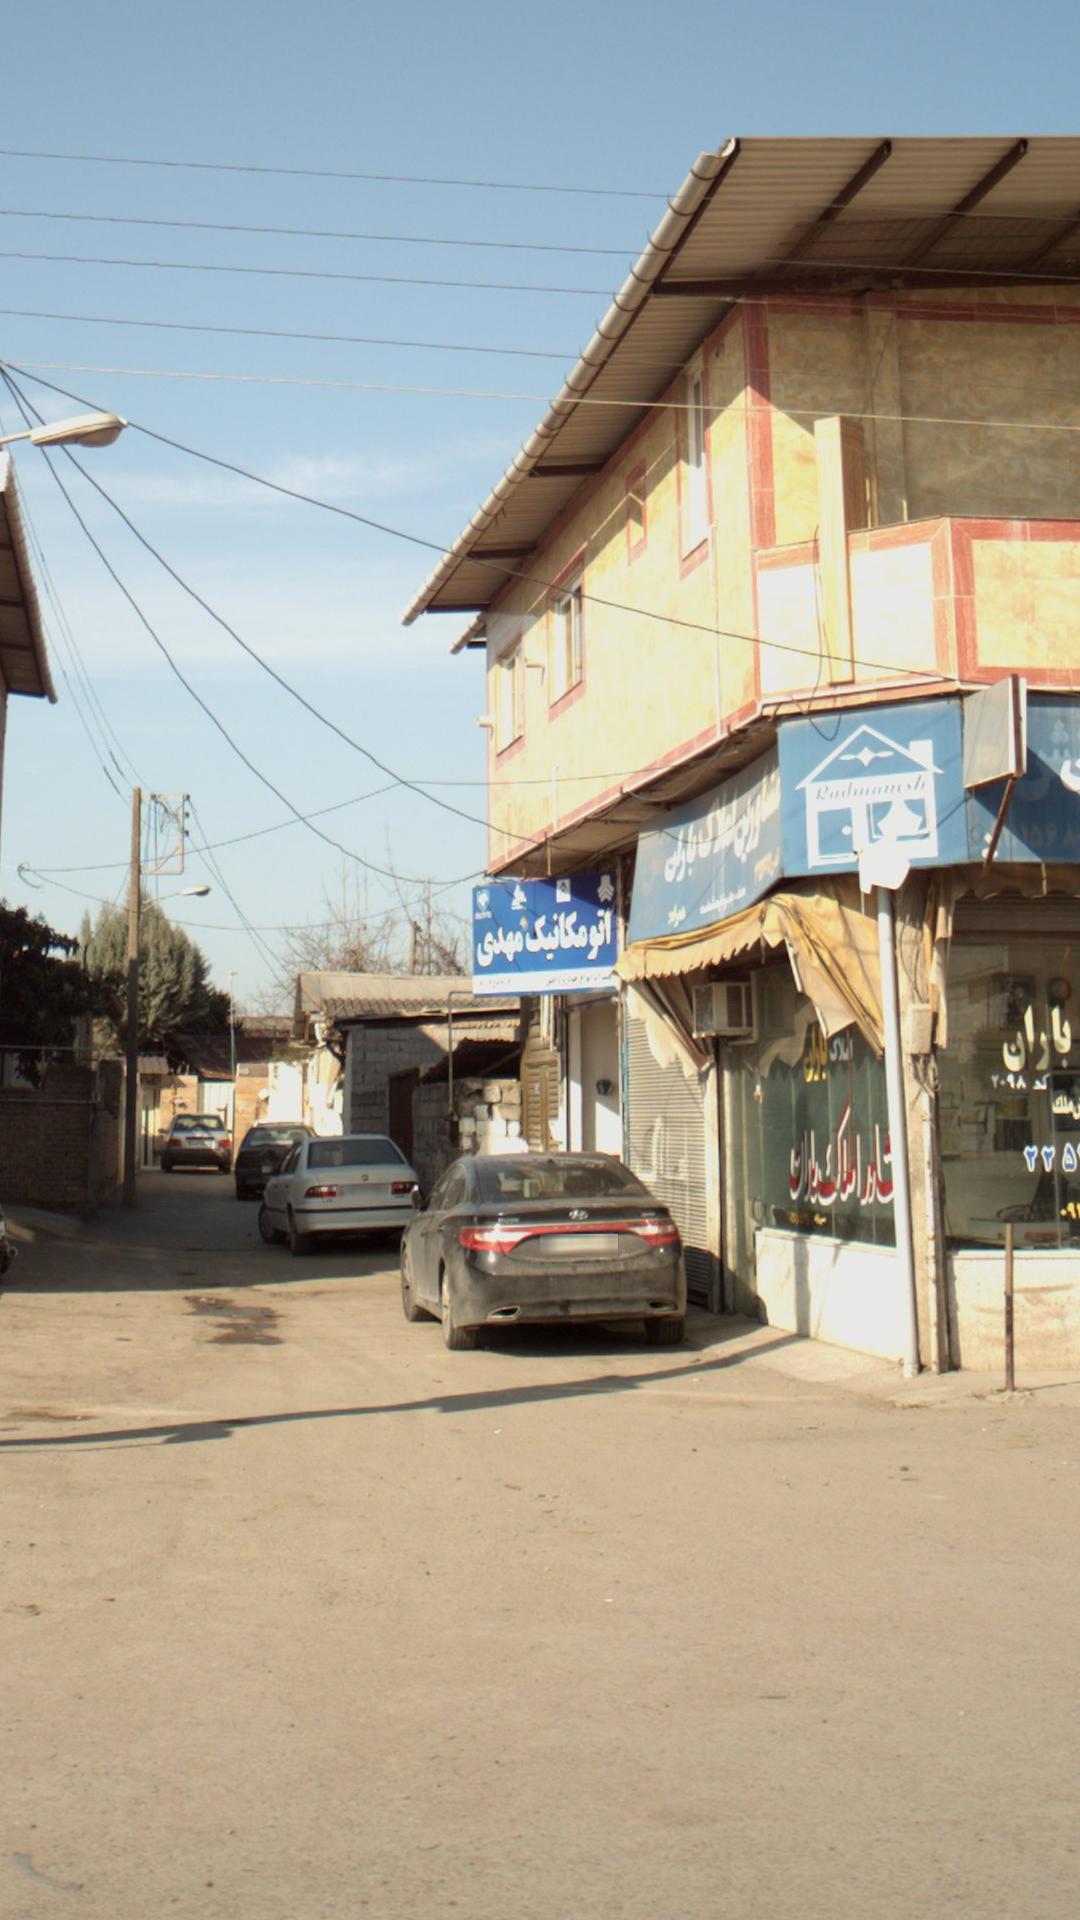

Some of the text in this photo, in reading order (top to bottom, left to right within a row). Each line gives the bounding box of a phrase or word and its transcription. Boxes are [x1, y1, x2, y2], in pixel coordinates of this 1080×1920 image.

[477, 926, 523, 967] مهدی
[526, 910, 588, 960] مکانیک
[1002, 1004, 1072, 1072] باران
